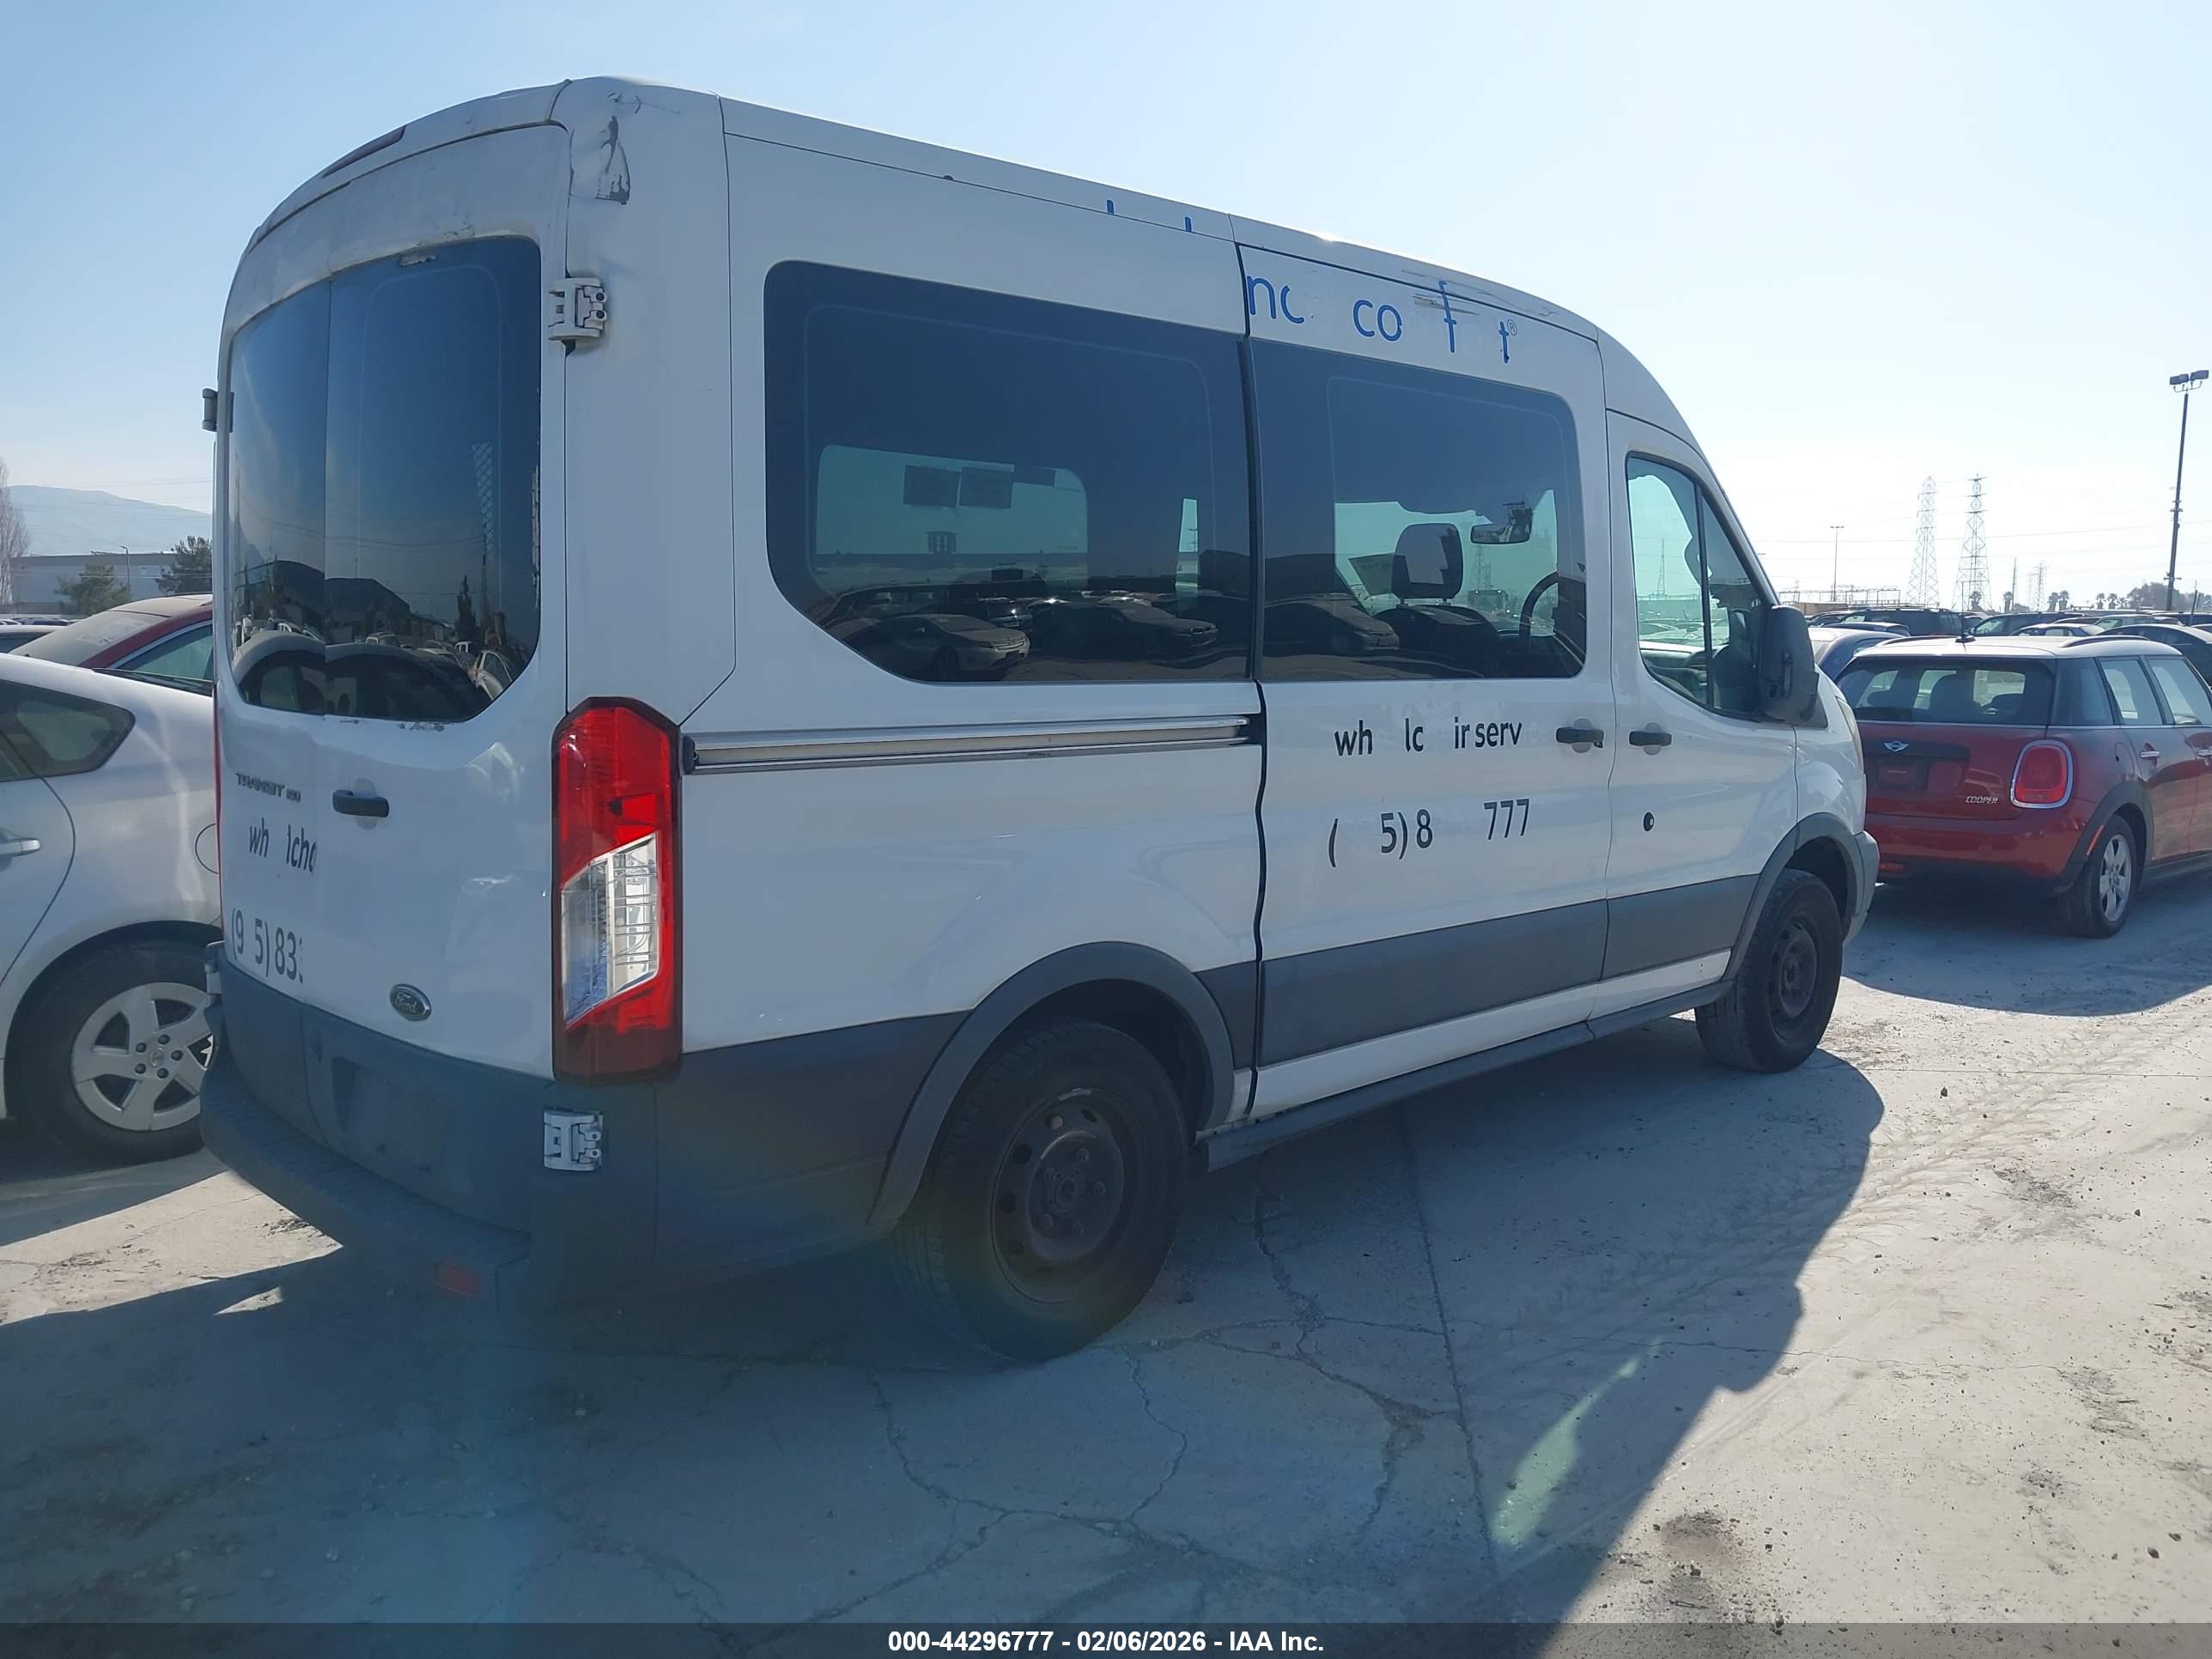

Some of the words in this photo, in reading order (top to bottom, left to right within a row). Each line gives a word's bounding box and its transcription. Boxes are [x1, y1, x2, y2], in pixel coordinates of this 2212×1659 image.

[1334, 720, 1373, 757] wh
[1483, 799, 1529, 840] 777
[1966, 795, 1998, 805] COOPER
[249, 817, 270, 858] wh
